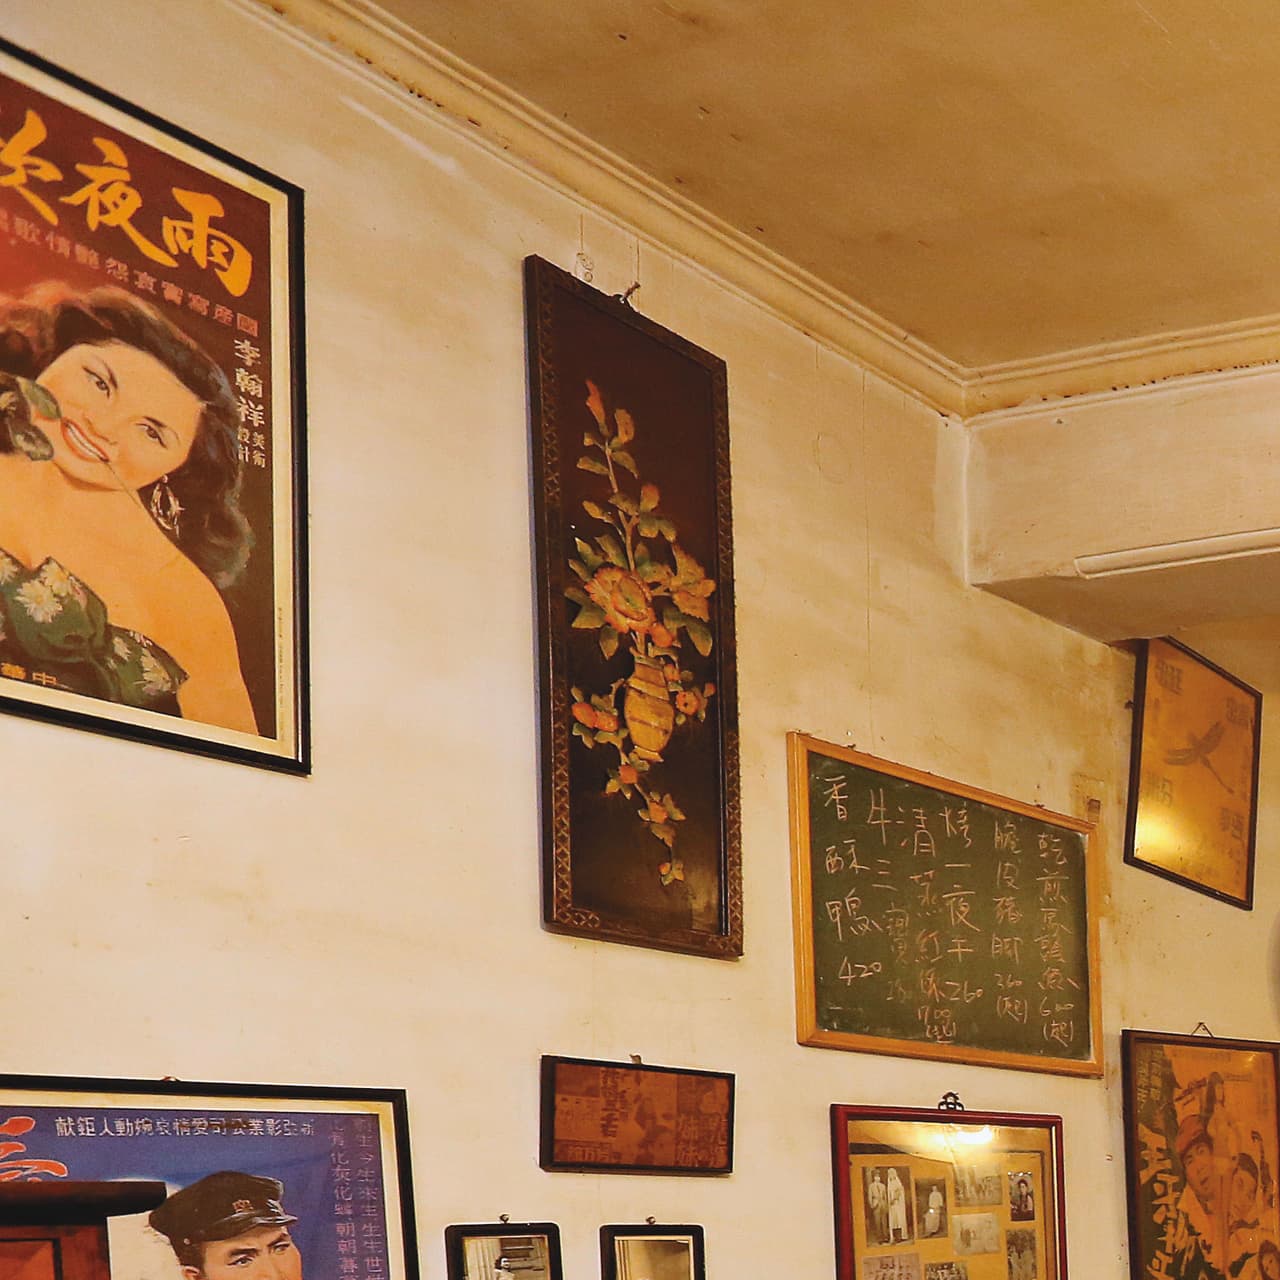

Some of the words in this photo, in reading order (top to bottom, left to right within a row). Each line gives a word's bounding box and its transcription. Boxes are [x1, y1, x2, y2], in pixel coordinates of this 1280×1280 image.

[824, 776, 883, 941] 香酥鴨
[838, 956, 882, 986] 420
[945, 981, 983, 1003] 260
